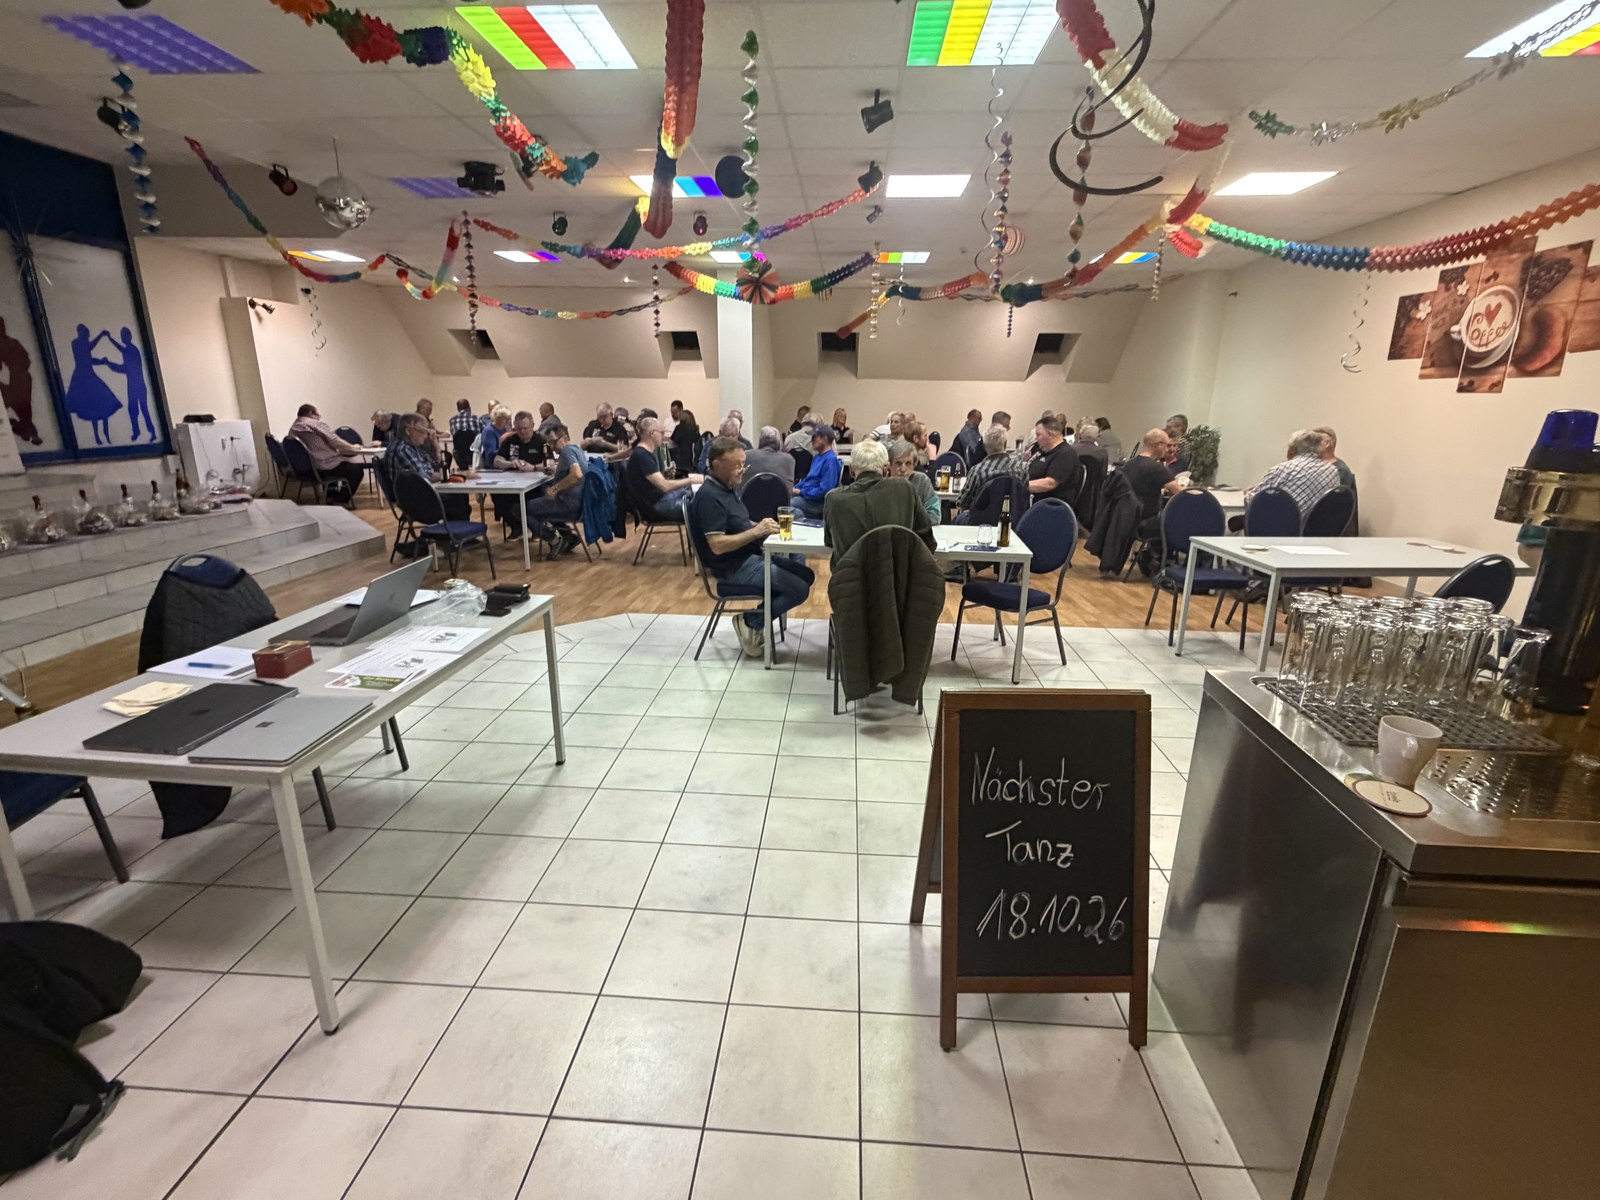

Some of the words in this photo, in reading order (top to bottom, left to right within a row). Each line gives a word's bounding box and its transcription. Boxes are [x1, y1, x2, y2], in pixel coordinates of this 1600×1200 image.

[971, 746, 1111, 811] Nächster
[985, 820, 1074, 868] Tanz
[976, 888, 1128, 944] 18.10.26
